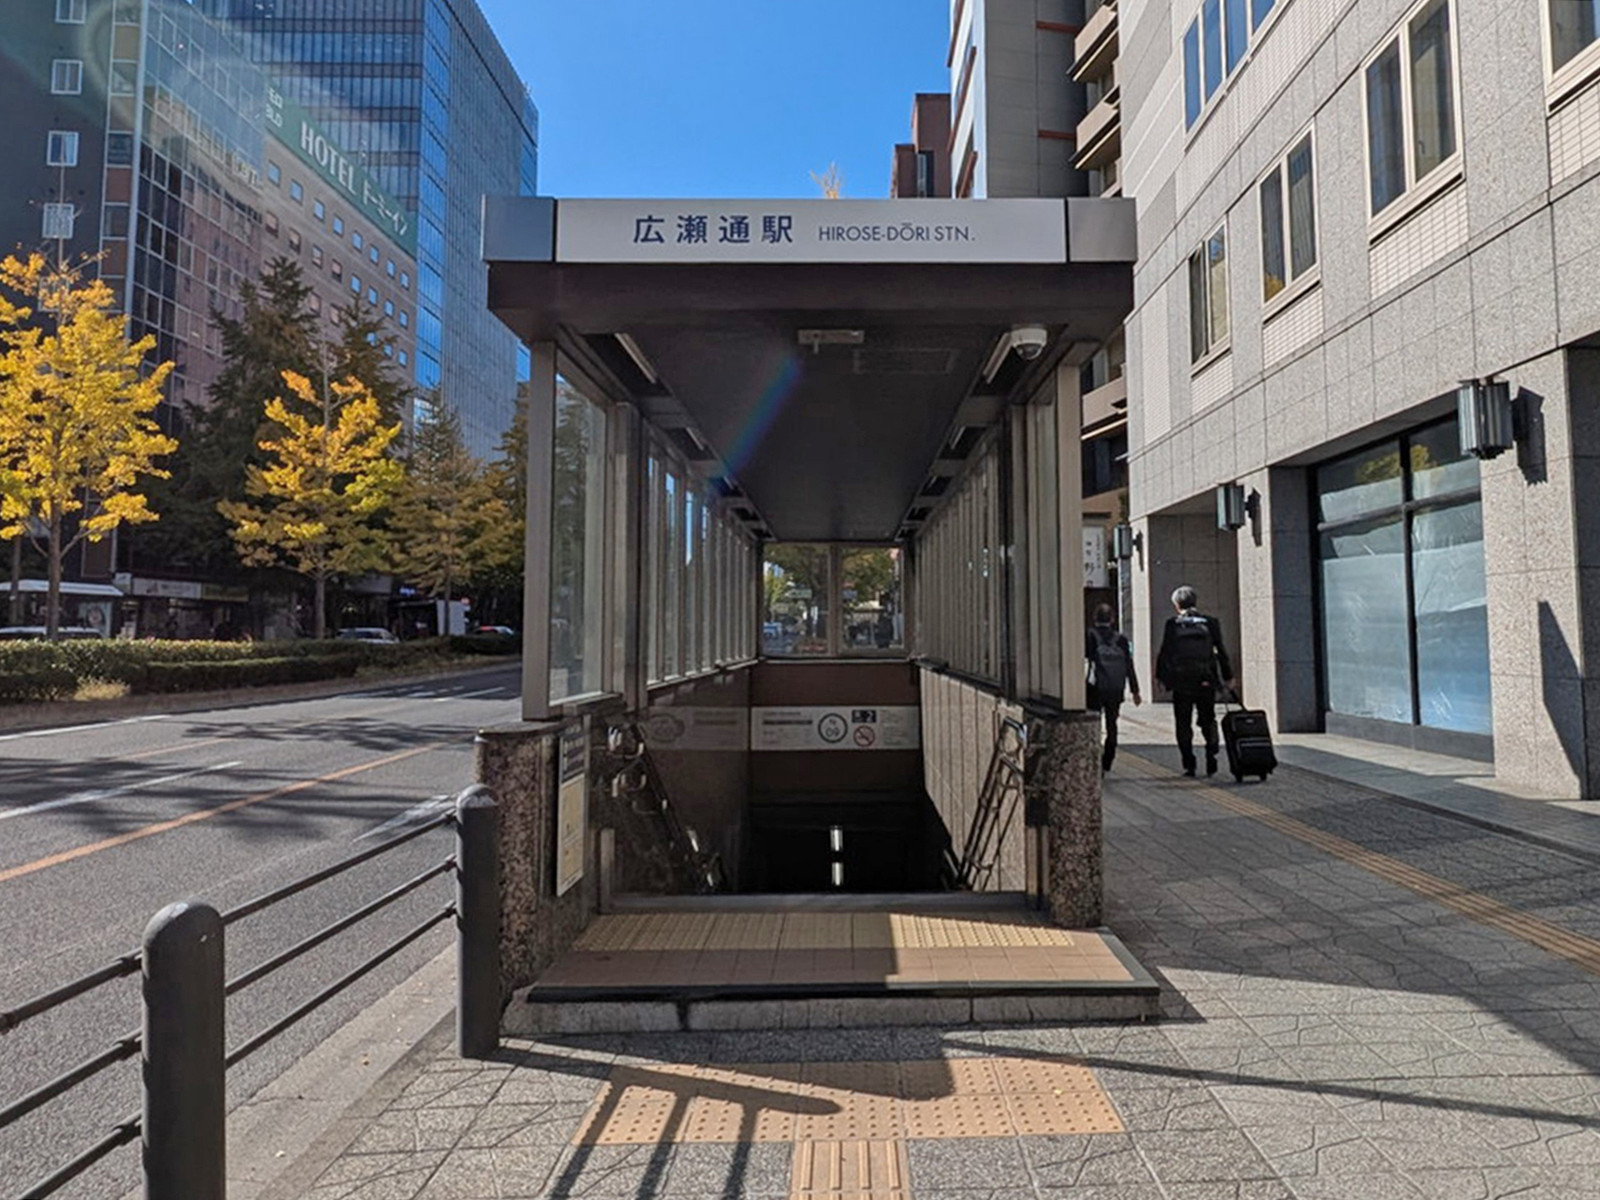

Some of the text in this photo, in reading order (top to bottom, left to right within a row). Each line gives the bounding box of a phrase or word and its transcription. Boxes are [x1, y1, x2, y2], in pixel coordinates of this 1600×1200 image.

[300, 121, 357, 195] HOTEL
[633, 214, 794, 245] 広瀬通駅
[934, 225, 976, 242] STN.
